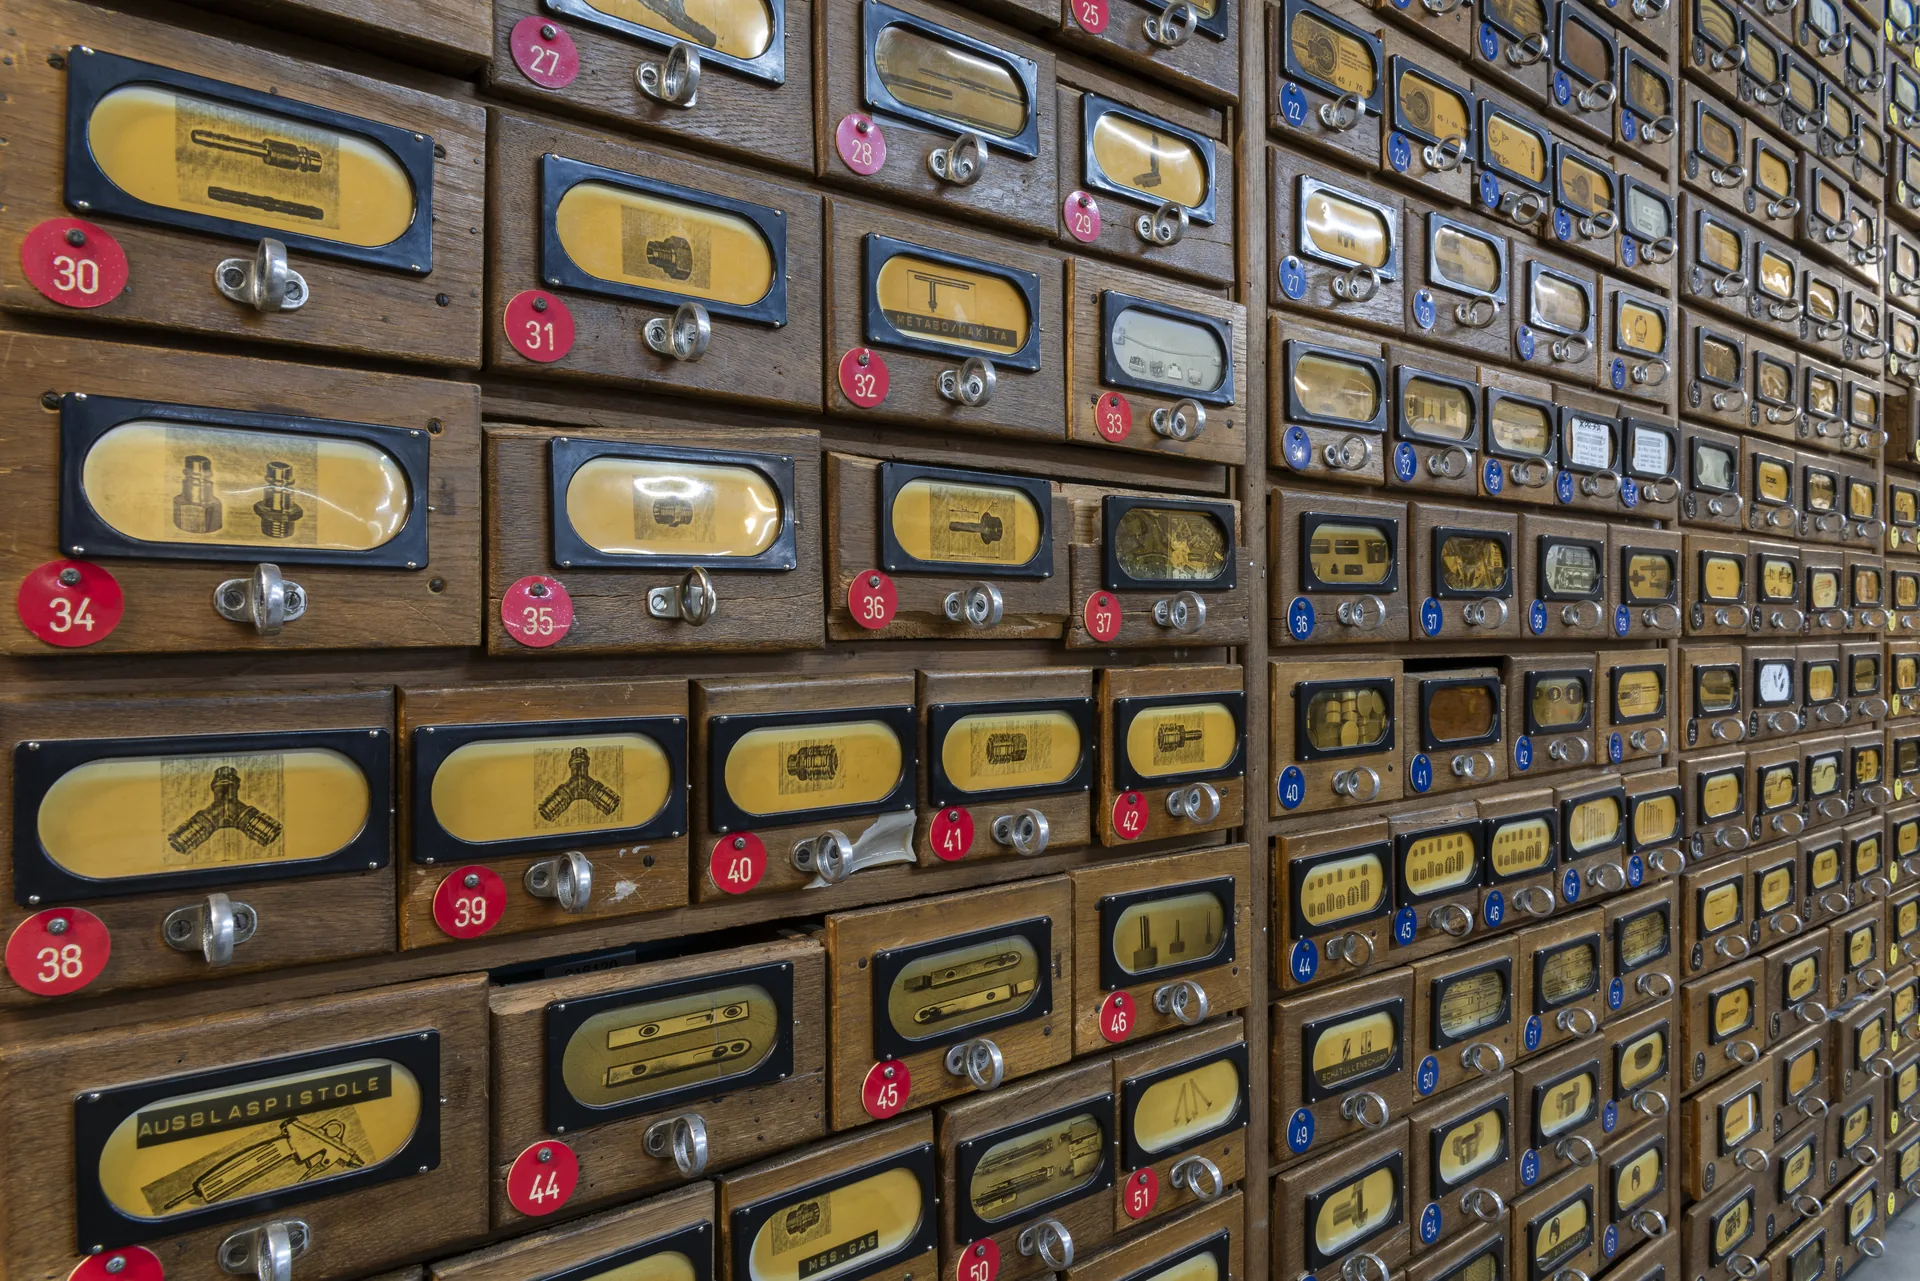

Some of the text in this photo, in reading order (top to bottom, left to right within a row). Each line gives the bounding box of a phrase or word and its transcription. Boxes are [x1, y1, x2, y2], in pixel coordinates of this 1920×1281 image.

[1083, 2, 1099, 26] 25
[530, 45, 559, 76] 27
[1559, 85, 1566, 100] 20
[1288, 101, 1300, 120] 22
[852, 140, 872, 165] 28
[1395, 148, 1405, 165] 23
[1486, 187, 1495, 202] 24
[1076, 213, 1090, 234] 29
[1559, 220, 1566, 236] 25
[53, 256, 98, 294] 30
[1288, 274, 1299, 292] 27
[1421, 307, 1429, 322] 28
[526, 321, 554, 351] 31
[896, 314, 1008, 341] METABO/MAKITA
[855, 374, 877, 398] 32
[1107, 413, 1122, 434] 33
[1401, 460, 1410, 475] 32
[49, 597, 95, 633] 34
[863, 596, 884, 619] 36
[523, 606, 553, 636] 35
[1096, 612, 1111, 633] 37
[1296, 616, 1307, 633] 36
[1428, 614, 1437, 629] 37
[1535, 615, 1542, 628] 38
[1619, 618, 1625, 631] 39
[1520, 751, 1528, 765] 42
[1418, 771, 1427, 785] 41
[1287, 785, 1297, 801] 40
[1123, 811, 1138, 830] 42
[944, 828, 961, 851] 41
[727, 857, 751, 883] 40
[1568, 883, 1575, 896] 47
[455, 896, 486, 927] 39
[1491, 907, 1498, 921] 46
[1401, 922, 1411, 938] 45
[36, 944, 82, 982] 38
[1300, 959, 1310, 975] 44
[1613, 992, 1619, 1005] 52
[1111, 1012, 1126, 1033] 46
[1530, 1031, 1537, 1045] 51
[1424, 1072, 1433, 1089] 50
[877, 1083, 898, 1109] 45
[138, 1077, 379, 1137] AUSBLASPISTOLE
[1296, 1127, 1307, 1145] 49
[1527, 1165, 1534, 1180] 55
[529, 1171, 559, 1203] 44
[1134, 1190, 1149, 1211] 51
[1427, 1220, 1436, 1237] 54
[970, 1261, 988, 1281] 50
